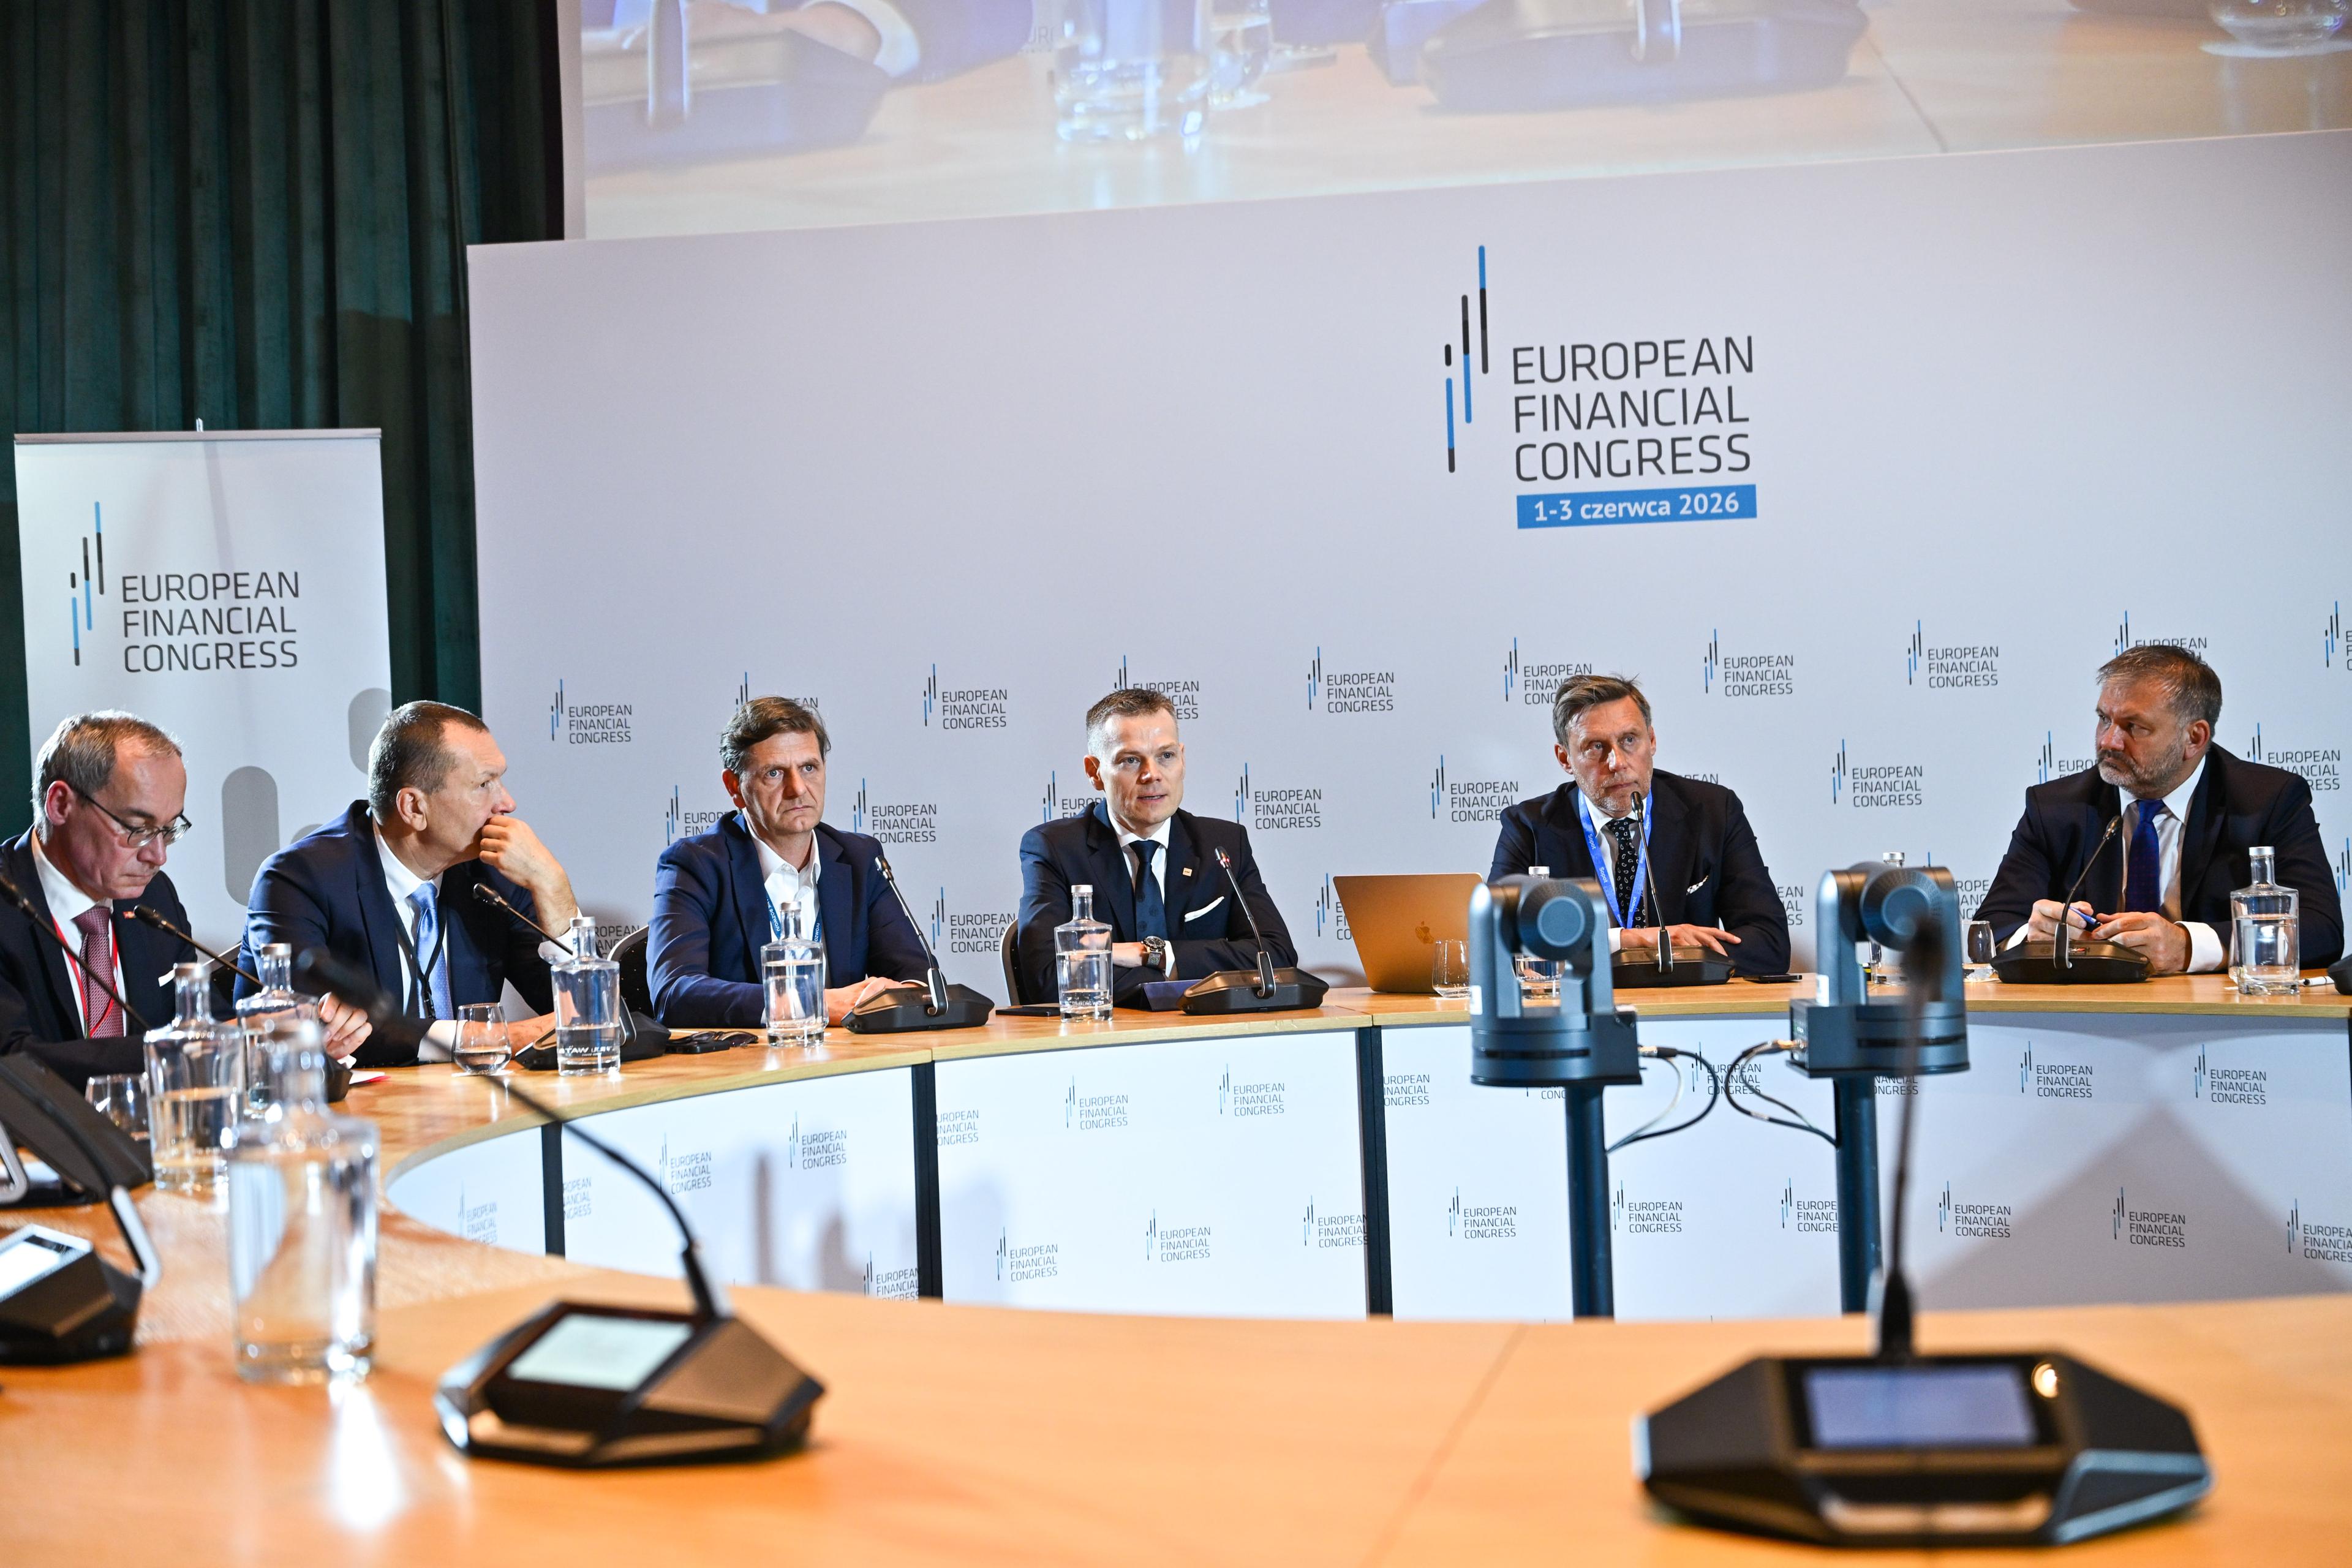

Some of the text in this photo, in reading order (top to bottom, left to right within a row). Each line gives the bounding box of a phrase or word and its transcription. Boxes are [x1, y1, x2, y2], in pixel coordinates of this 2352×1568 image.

[1513, 336, 1752, 384] EUROPEAN
[1515, 386, 1749, 433] FINANCIAL
[1516, 434, 1750, 481] CONGRESS
[1534, 492, 1738, 521] 1-3 czerwca 2026
[123, 571, 298, 603] EUROPEAN
[124, 606, 296, 638] FINANCIAL
[124, 641, 297, 673] CONGRESS
[1928, 647, 1998, 660] EUROPEAN
[1724, 655, 1793, 669] EUROPEAN
[1929, 660, 1997, 674] FINANCIAL
[1524, 663, 1592, 677] EUROPEAN
[1725, 669, 1792, 682] FINANCIAL
[1327, 673, 1393, 685] EUROPEAN
[1525, 678, 1562, 690] FINAN
[1929, 674, 1997, 688] CONGRESS
[1328, 686, 1392, 699] FINANCIAL
[1725, 683, 1792, 696] CONGRESS
[943, 690, 1007, 703] EUROPEAN
[569, 705, 631, 717] EUROPEAN
[943, 703, 1006, 715] FINANCIAL
[1328, 699, 1393, 713] CONGRESS
[570, 718, 630, 730] FINANCIAL
[943, 716, 1006, 729] CONGRESS
[570, 731, 631, 744] CONGRESS
[2268, 750, 2340, 764] EUROPEAN
[1852, 766, 1922, 779] EUROPEAN
[2281, 764, 2339, 777] ANCIAL
[1451, 782, 1518, 794] EUROPEAN
[1853, 780, 1921, 793] FINANCIAL
[2306, 778, 2340, 791] RESS
[1255, 789, 1321, 802] EUROPEAN
[1853, 794, 1921, 807] CONGRESS
[872, 804, 936, 816] EUROPEAN
[1256, 803, 1320, 816] FINANCIAL
[1452, 809, 1501, 822] CONGRE
[684, 812, 726, 824] EUROP
[873, 818, 935, 830] FINANCIAL
[1256, 816, 1321, 829] CONGRESS
[1599, 867, 1608, 883] Sopot
[1956, 880, 1989, 892] ROPE
[951, 913, 1016, 925] EUROPEAN
[595, 925, 639, 937] ROPEAN
[951, 927, 1005, 940] FINANCIA
[951, 941, 1000, 953] CONGRE
[2037, 1065, 2092, 1075] EUROPEAN
[2211, 1069, 2266, 1081] EUROPEAN
[1384, 1074, 1430, 1085] UROPEAN
[1707, 1074, 1760, 1084] FNNCIAL
[1874, 1075, 1918, 1084] NANCIAL
[2037, 1076, 2092, 1087] FINANCIAL
[1234, 1083, 1284, 1095] EUROPEAN
[1384, 1085, 1429, 1096] INANCIAL
[1874, 1086, 1918, 1095] NGRESS
[2038, 1087, 2092, 1098] CONGRESS
[2211, 1081, 2265, 1093] FINANCIAL
[1080, 1095, 1128, 1107] EUROPEAN
[1234, 1094, 1283, 1106] FINANCIAL
[1384, 1095, 1430, 1106] ONGRESS
[2212, 1093, 2266, 1104] CONGRESS
[937, 1109, 979, 1123] UROPEAN
[1080, 1106, 1127, 1118] FINANCIAL
[1235, 1104, 1284, 1116] CONGRESS
[937, 1121, 978, 1135] INANCIAL
[1080, 1117, 1128, 1129] CONGRESS
[802, 1131, 846, 1145] EUROPEAN
[938, 1132, 979, 1146] ONGRESS
[802, 1143, 845, 1157] FINANCIAL
[671, 1152, 711, 1169] EUROPEAN
[803, 1153, 846, 1169] CONGRESS
[1629, 1202, 1682, 1211] EUROPEAN
[1797, 1200, 1838, 1210] EUROPE
[1955, 1205, 2010, 1215] EUROPEAN
[1464, 1207, 1516, 1217] EUROPEAN
[1629, 1213, 1681, 1222] FINANCIAL
[1797, 1212, 1838, 1221] FINANCI
[2129, 1212, 2185, 1224] EUROPEAN
[1318, 1214, 1367, 1226] EUROPEAN
[1464, 1218, 1515, 1228] FINANCIAL
[1956, 1216, 2010, 1227] FINANCIAL
[1319, 1225, 1367, 1237] FINANCIAL
[1465, 1228, 1515, 1238] CONGRESS
[1629, 1223, 1681, 1232] CONGRESS
[1798, 1222, 1839, 1232] CONGRE
[1956, 1227, 2010, 1237] CONGRESS
[2130, 1223, 2184, 1235] FINANCIAL
[2304, 1224, 2352, 1238] EUROPEA
[1161, 1227, 1210, 1240] EUROPEAN
[1161, 1238, 1209, 1250] FINANCIAL
[1319, 1236, 1367, 1248] CONGRESS
[2130, 1234, 2185, 1247] CONGRESS
[2304, 1236, 2352, 1250] FINANCIA
[1011, 1245, 1057, 1259] EUROPEAN
[1161, 1249, 1210, 1262] CONGRESS
[2304, 1248, 2352, 1262] CONGRES
[1011, 1256, 1056, 1270] FINANCIAL
[1011, 1267, 1057, 1281] CONGRESS
